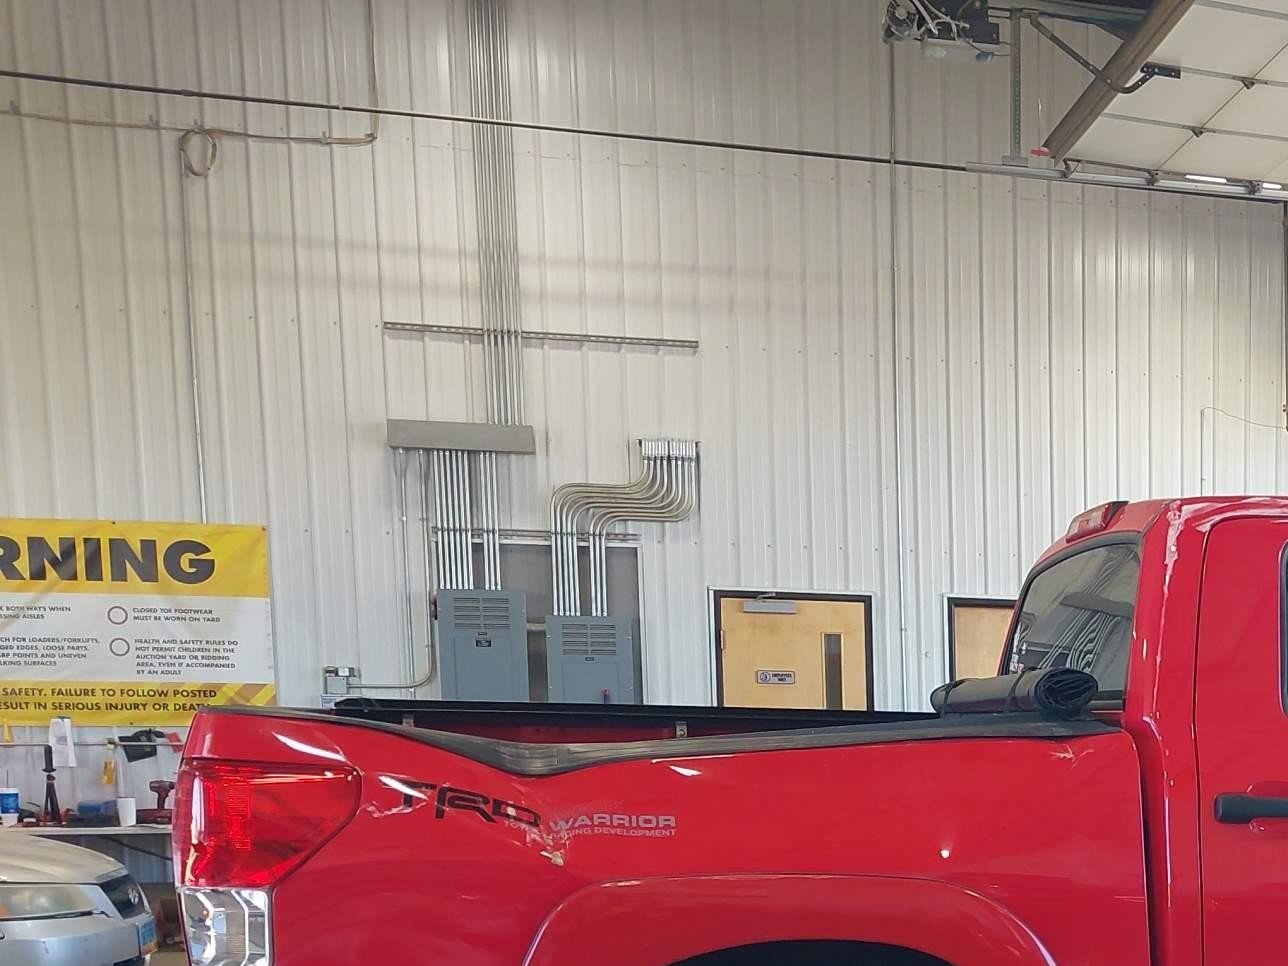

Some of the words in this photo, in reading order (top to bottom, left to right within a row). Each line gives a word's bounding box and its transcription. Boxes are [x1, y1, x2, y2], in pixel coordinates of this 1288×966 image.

[2, 687, 47, 696] SAFETY.
[51, 688, 97, 697] FAILURE
[101, 688, 116, 697] TO
[120, 689, 169, 698] FOLLOW
[173, 689, 217, 698] POSTED
[34, 702, 47, 710] IN
[51, 702, 101, 711] SERIOUS
[105, 703, 148, 712] INJURY
[152, 703, 170, 712] OR
[380, 776, 541, 827] TRD
[550, 813, 676, 831] WARRIOR
[594, 826, 676, 838] DEVELOPMENT
